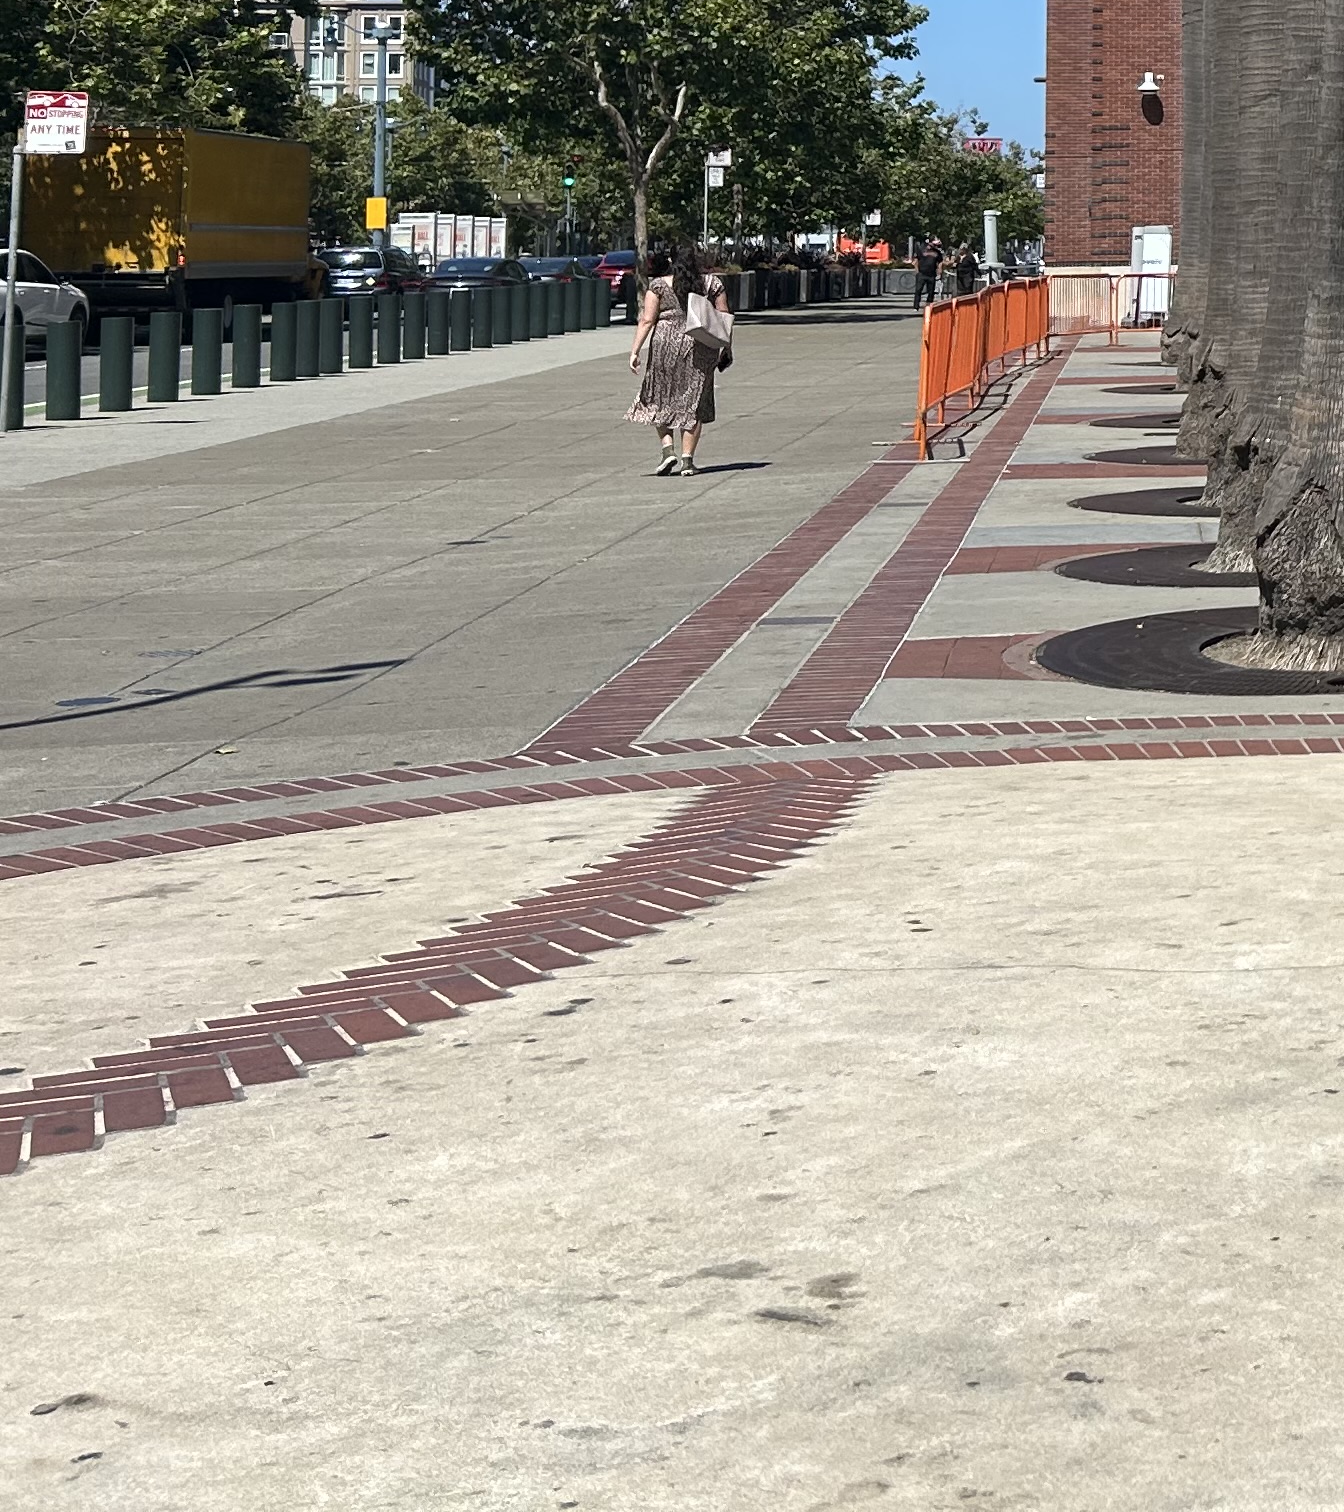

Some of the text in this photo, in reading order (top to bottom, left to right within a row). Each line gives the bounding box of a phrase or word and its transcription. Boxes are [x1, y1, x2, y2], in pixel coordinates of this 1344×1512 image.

[29, 109, 84, 118] NO STOPPING
[30, 125, 81, 135] ANY TIME
